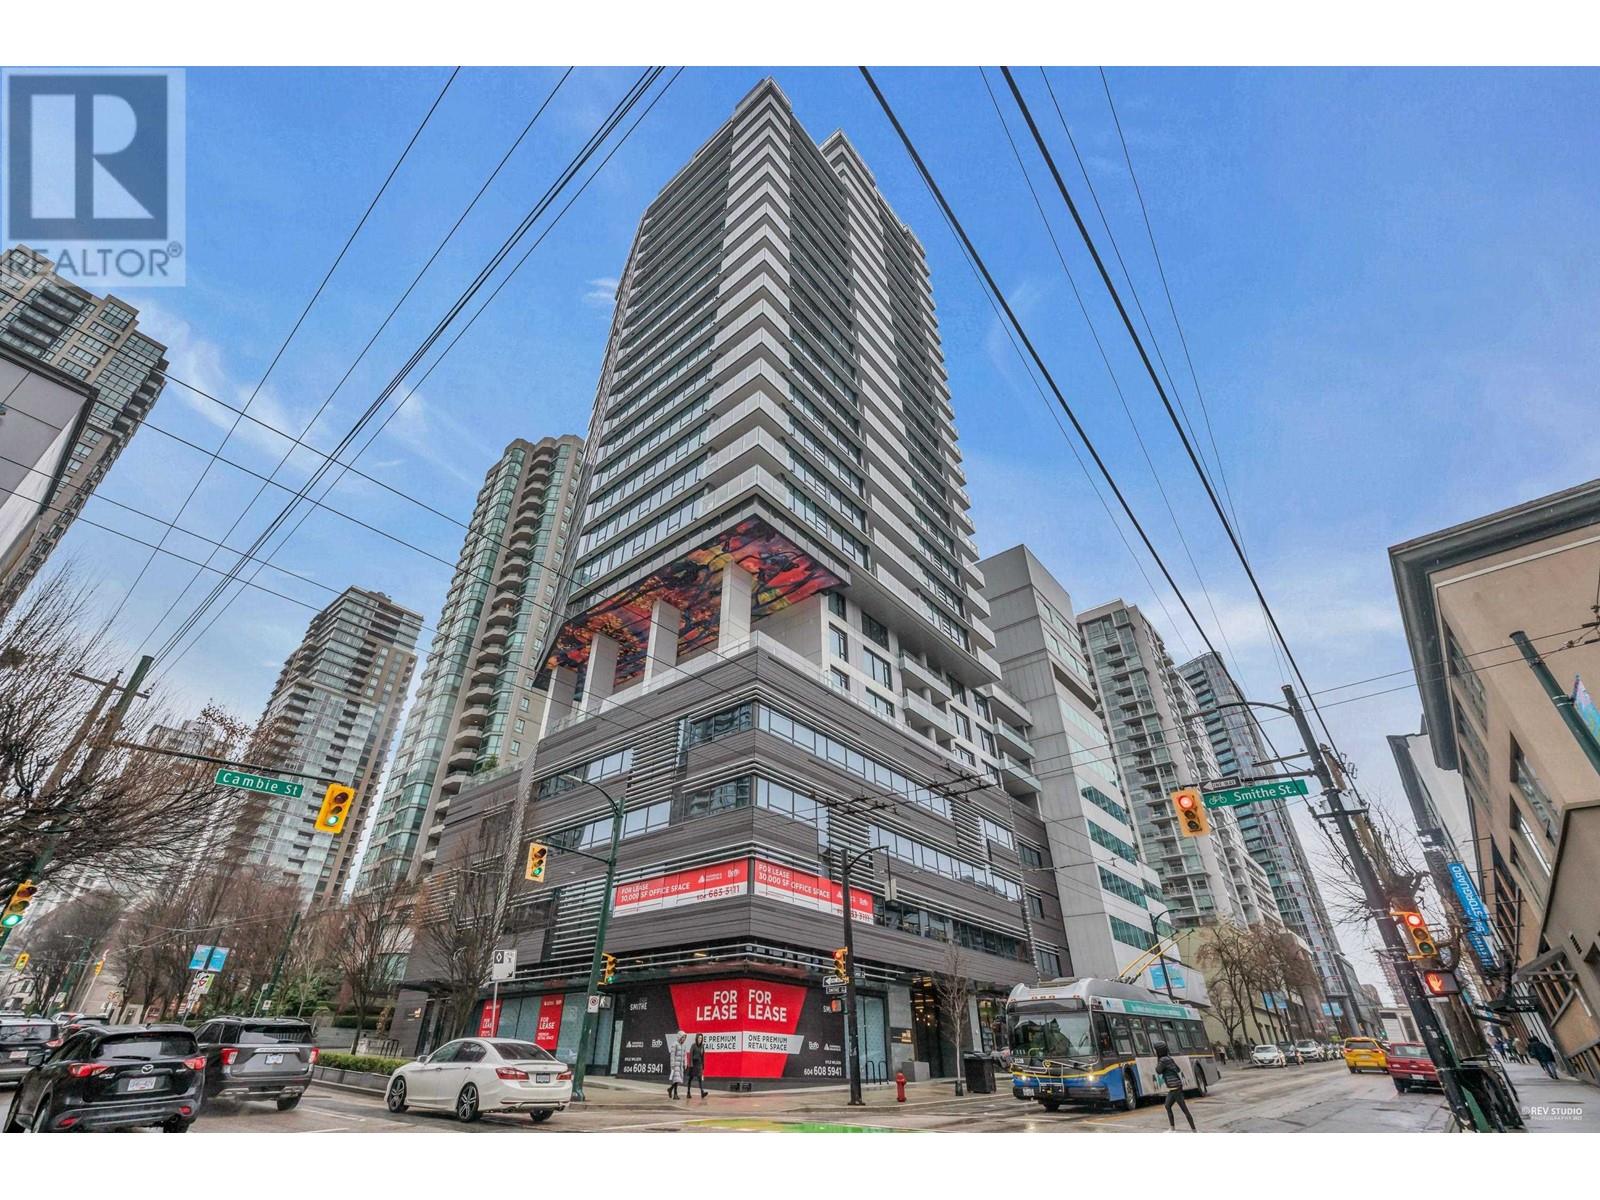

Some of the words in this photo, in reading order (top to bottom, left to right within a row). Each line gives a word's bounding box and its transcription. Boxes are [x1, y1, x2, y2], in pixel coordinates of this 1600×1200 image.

[222, 772, 278, 792] Cambie
[285, 783, 298, 796] St
[1233, 787, 1276, 802] Smithe
[1278, 785, 1297, 795] St.
[759, 864, 771, 873] FOR
[772, 868, 790, 879] LEASE
[621, 886, 632, 894] FOR
[633, 883, 649, 893] LEASE
[649, 886, 669, 897] OFFICE
[671, 882, 690, 893] SPACE
[782, 879, 790, 888] SF
[791, 881, 812, 893] OFFICE
[813, 888, 831, 899] SPACE
[713, 990, 738, 1004] FOR
[748, 989, 772, 1004] FOR
[629, 1002, 648, 1011] SMITHE
[696, 1004, 738, 1021] LEASE
[748, 1004, 787, 1022] LEASE
[539, 1022, 555, 1030] LEASE
[708, 1035, 737, 1043] PREMIUM
[748, 1034, 761, 1042] ONE
[762, 1035, 788, 1044] PREMIUM
[748, 1042, 768, 1050] RETAIL
[769, 1043, 787, 1051] SPACE
[633, 1063, 647, 1073] 608
[647, 1063, 663, 1073] 5941
[804, 1068, 813, 1076] 604
[813, 1066, 826, 1076] 608
[827, 1066, 842, 1076] 5941
